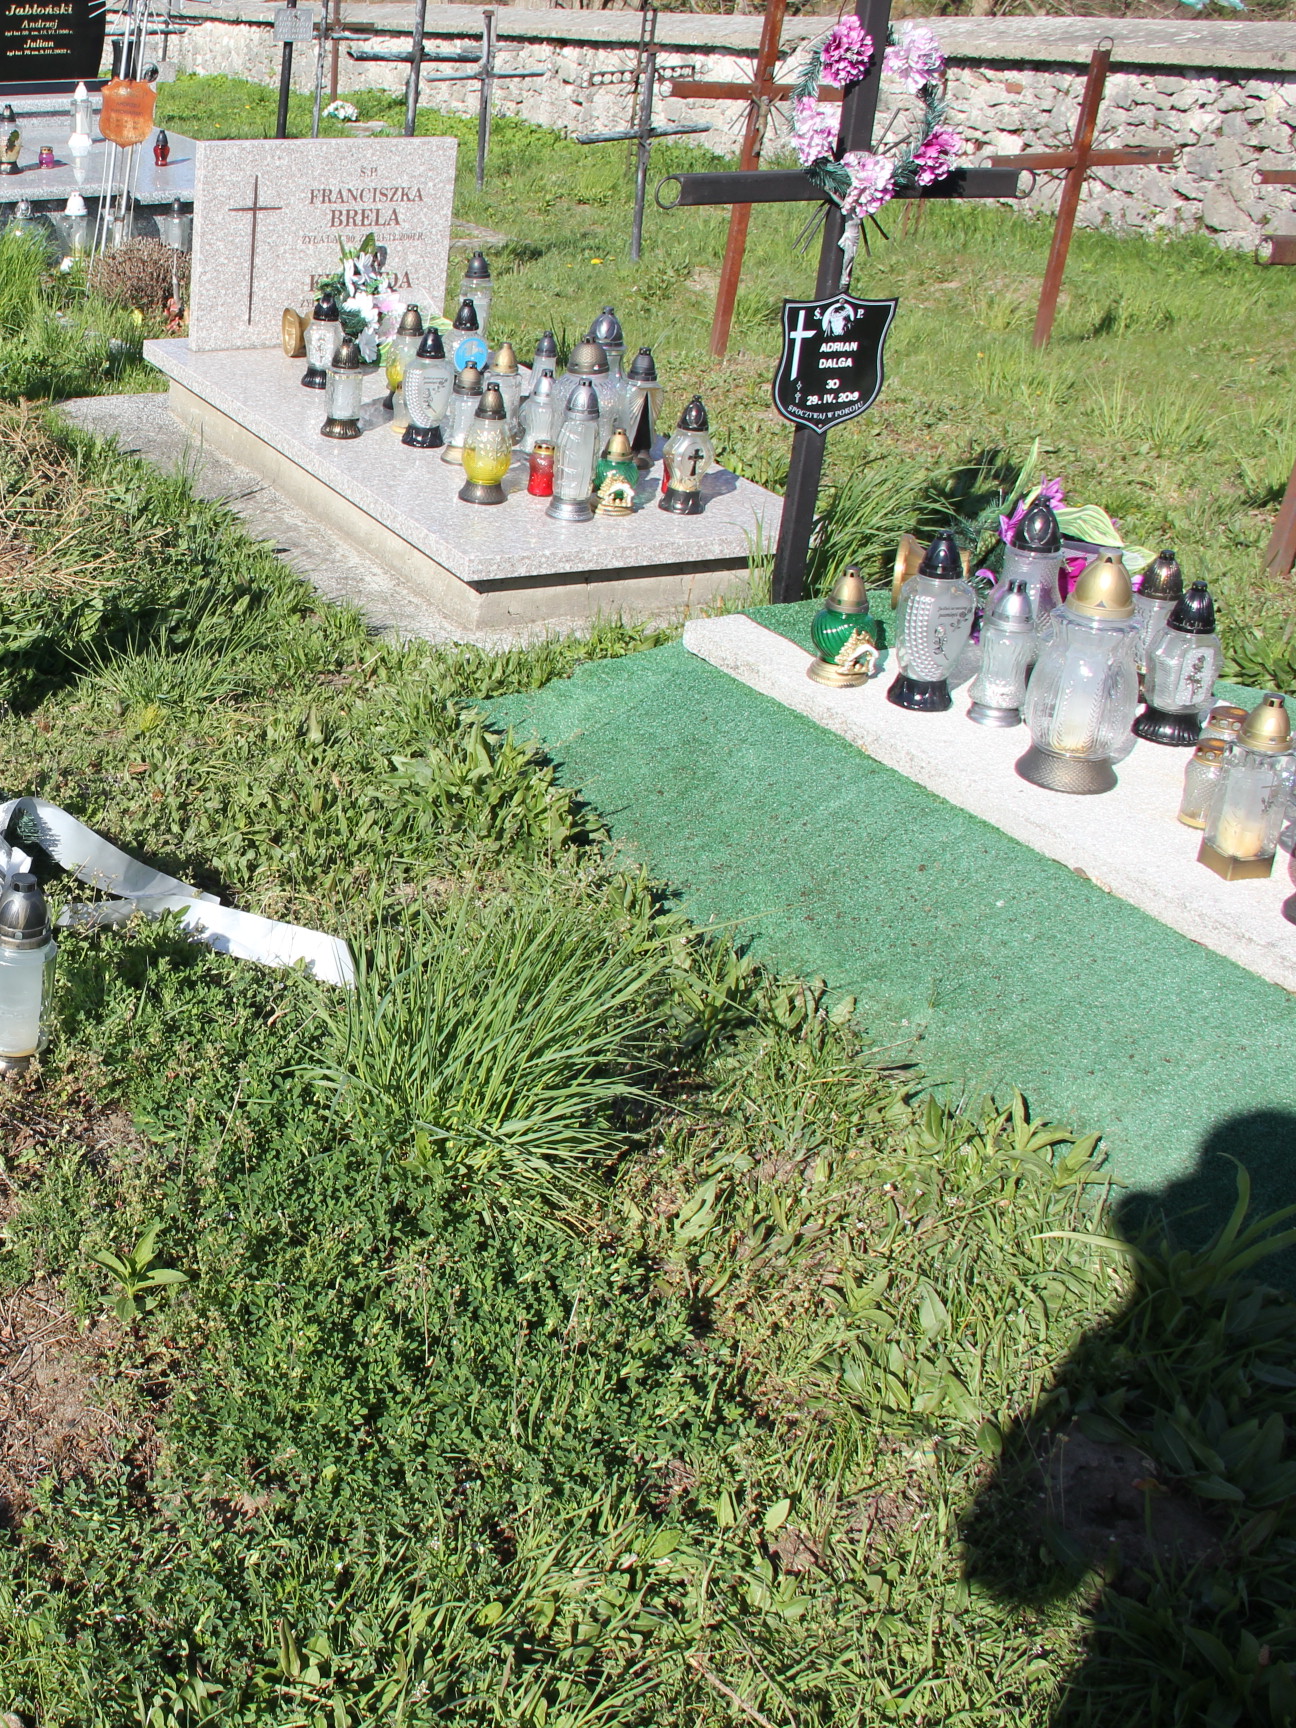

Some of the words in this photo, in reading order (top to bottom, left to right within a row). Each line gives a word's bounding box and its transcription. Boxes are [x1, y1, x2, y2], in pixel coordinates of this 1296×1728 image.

[6, 4, 72, 16] Jabłoński
[21, 20, 58, 29] Andrzej
[23, 39, 54, 48] Julian
[309, 187, 424, 204] FRANCISZKA
[330, 208, 401, 228] BRELA
[819, 341, 858, 353] ADRIAN
[818, 357, 853, 369] DALGA
[825, 379, 839, 389] 30
[806, 394, 822, 406] 29.
[824, 393, 836, 404] IV.
[787, 404, 826, 420] SPOCZYWAJ
[834, 401, 864, 418] POKOJU
